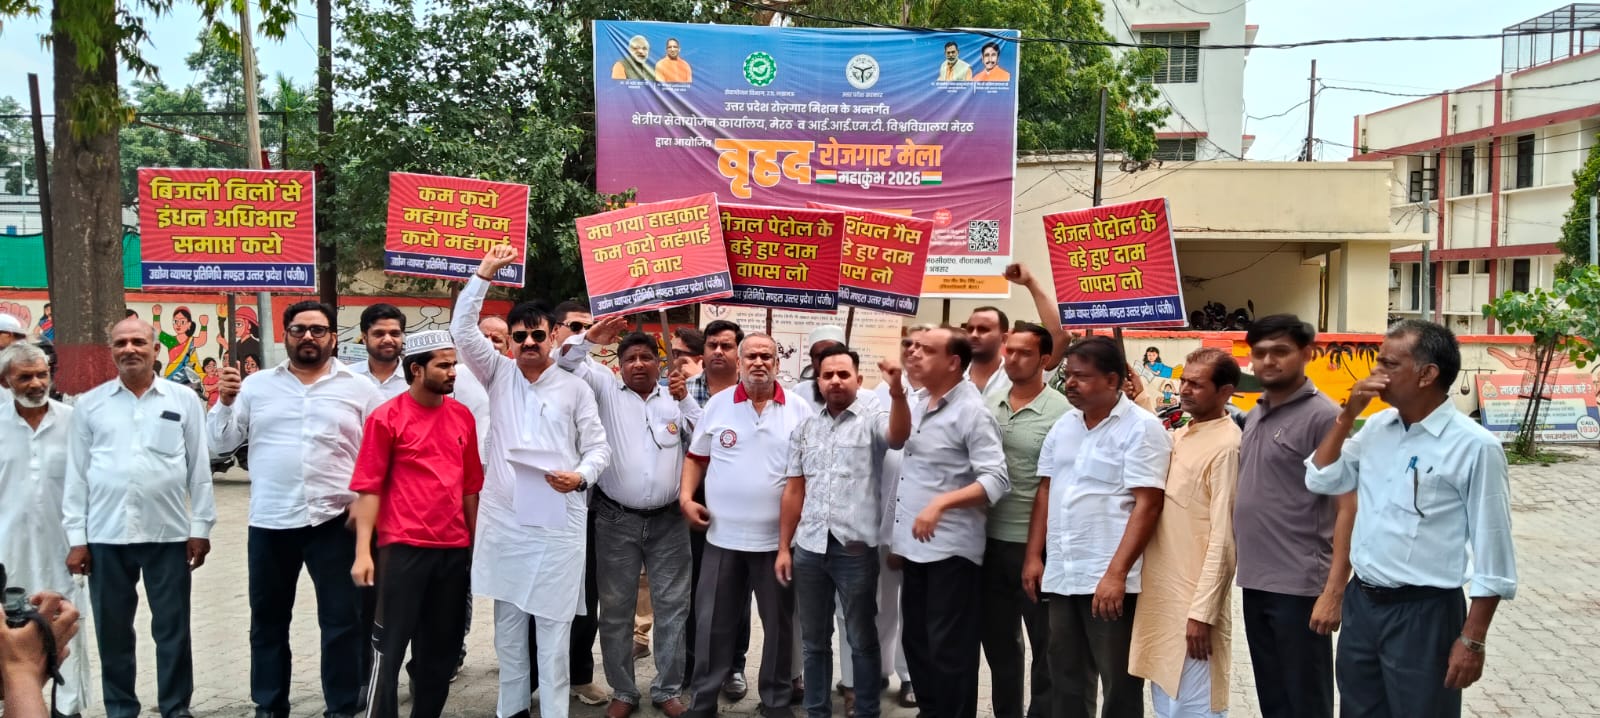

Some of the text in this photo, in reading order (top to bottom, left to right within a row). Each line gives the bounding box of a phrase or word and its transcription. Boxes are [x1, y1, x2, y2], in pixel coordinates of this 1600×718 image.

[724, 102, 744, 111] उत्तर
[746, 100, 769, 112] प्रदेश
[809, 102, 838, 114] मिशन
[840, 102, 851, 114] के
[632, 112, 662, 126] क्षेत्रीय
[664, 114, 716, 127] सेवायोजन
[769, 117, 792, 130] मेरठ
[797, 120, 806, 130] व
[887, 119, 949, 133] विश्वविद्यालय
[950, 120, 974, 132] मेरठ
[655, 137, 712, 148] द्वारा आयोजित
[714, 136, 944, 199] वृहद रोजगार मेला
[838, 168, 920, 189] महाकुंभ 2026
[149, 176, 303, 202] बिजली बिलों से
[418, 186, 500, 209] कम करो
[156, 203, 299, 229] इंधन अधिभार
[402, 206, 511, 233] महंगाई कम
[586, 204, 710, 240] मच गया हाहाकार
[767, 215, 814, 237] पेट्रोल
[816, 218, 835, 237] के
[1052, 209, 1157, 245] डीजल पेट्रोल के
[240, 232, 283, 255] करो
[401, 228, 440, 247] करो
[592, 222, 712, 263] कम करो महंगाई
[893, 222, 923, 245] गैस
[729, 237, 819, 261] बड़े हुए दाम
[856, 243, 879, 262] हुए
[882, 247, 915, 265] दाम
[1068, 242, 1146, 272] बड़े हुए दाम
[170, 269, 192, 280] व्यापार
[193, 266, 222, 281] प्रतिनिधि
[265, 267, 282, 282] प्रदेश
[628, 256, 683, 278] की मार
[736, 262, 810, 282] वापस लो
[871, 266, 894, 285] लो
[1078, 266, 1143, 293] वापस लो
